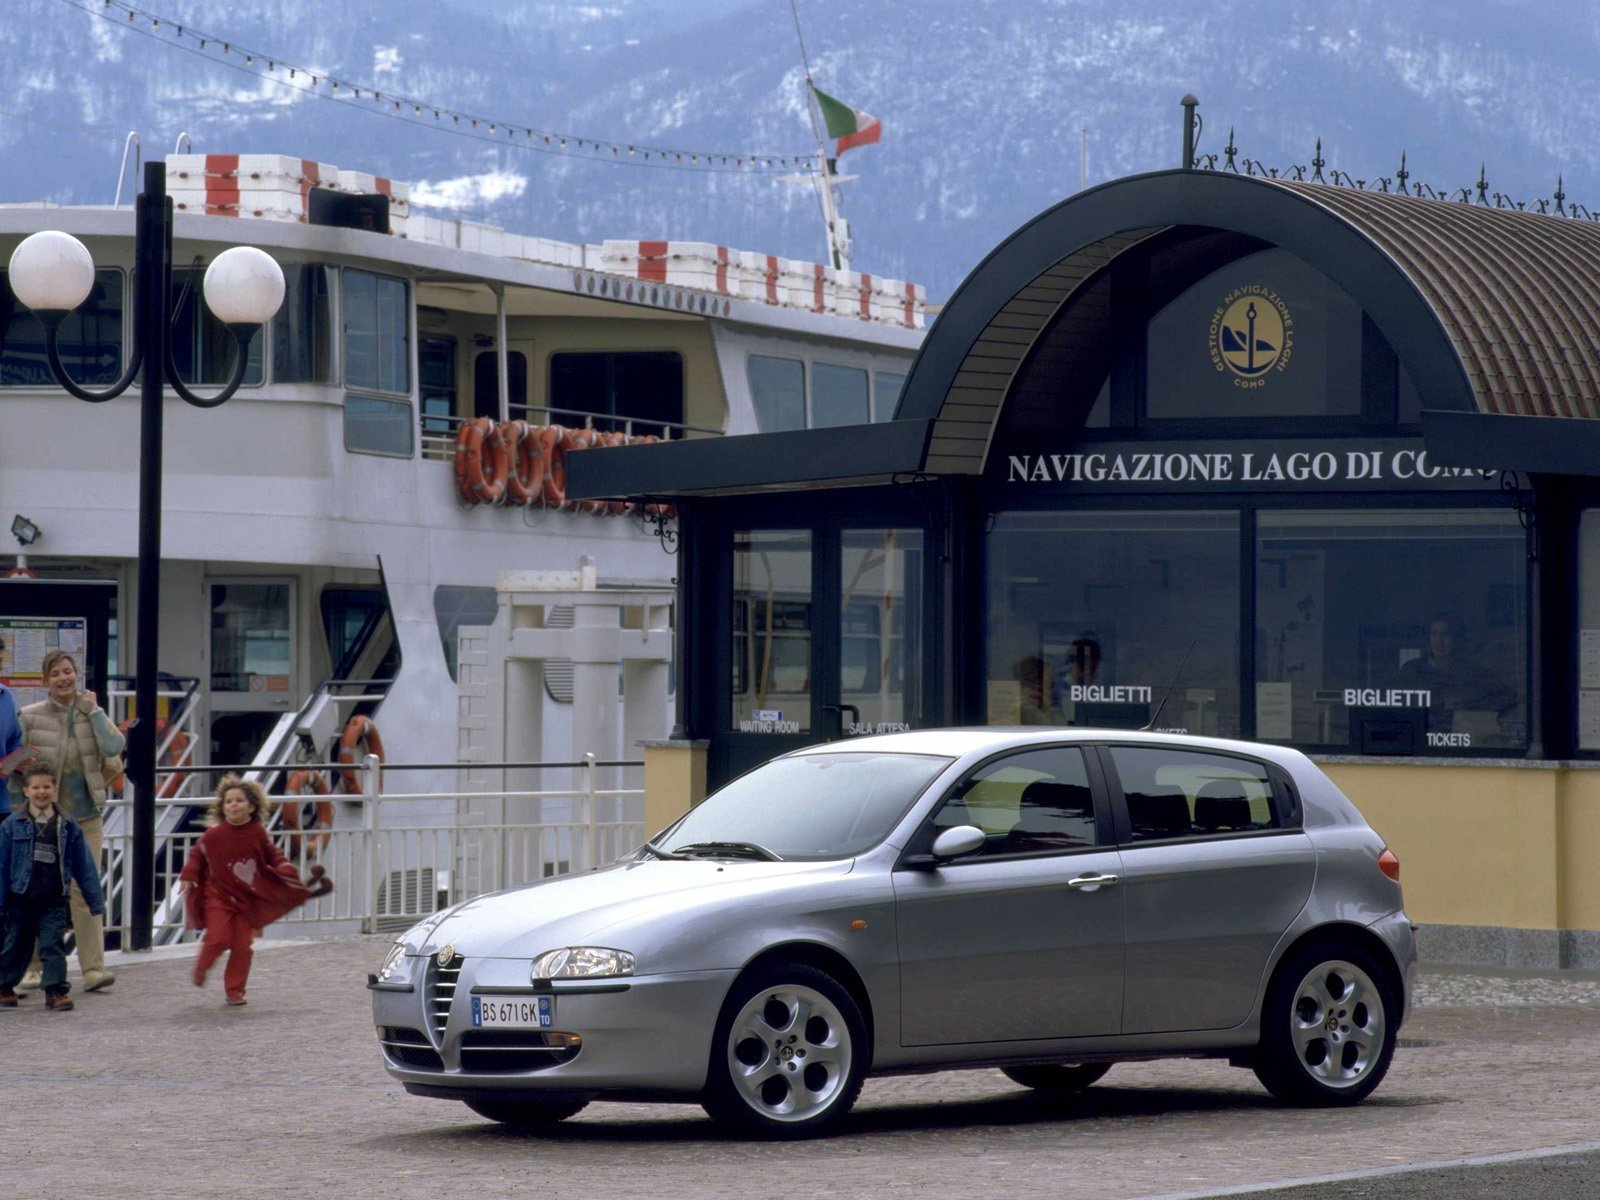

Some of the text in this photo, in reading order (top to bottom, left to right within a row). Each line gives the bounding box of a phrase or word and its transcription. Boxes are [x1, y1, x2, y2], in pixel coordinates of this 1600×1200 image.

[1224, 285, 1293, 327] NAVIGAZIONE
[1277, 330, 1294, 372] LAGHI
[1234, 378, 1266, 389] COMO
[1007, 453, 1233, 482] NAVIGAZIONE
[1241, 451, 1337, 481] LAGO
[1345, 450, 1383, 480] DI
[1070, 685, 1152, 703] BIGLIETTI
[1343, 688, 1431, 707] BIGLIETTI
[740, 720, 800, 734] WAITING ROOM
[848, 722, 873, 735] SALA
[1426, 732, 1471, 747] TICKETS
[482, 1003, 496, 1021] BS
[541, 1015, 550, 1025] TO
